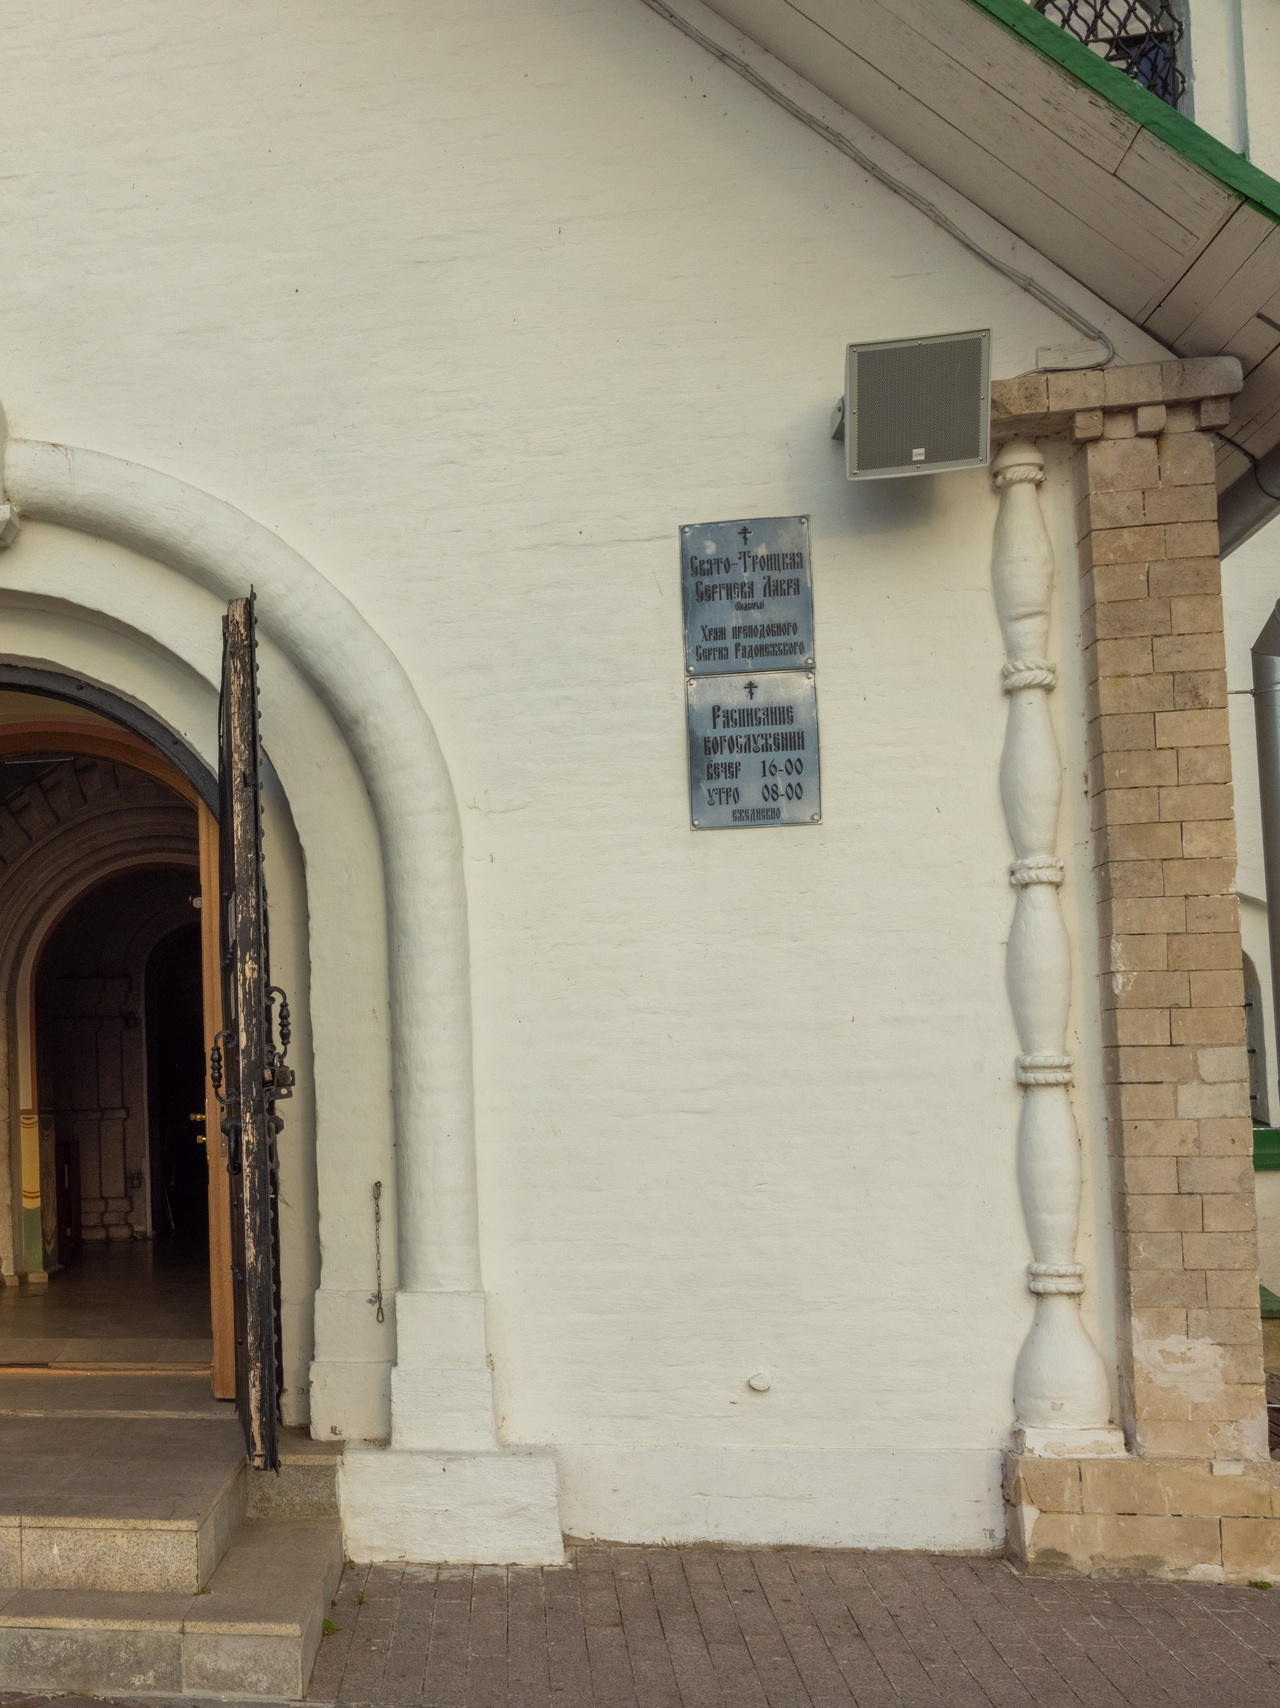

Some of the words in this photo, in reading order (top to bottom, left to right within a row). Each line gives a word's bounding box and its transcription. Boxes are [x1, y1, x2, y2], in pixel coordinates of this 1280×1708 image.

[689, 550, 803, 577] Свято-Троицкая
[695, 581, 754, 602] Сергиева
[763, 575, 800, 598] Лавра
[701, 625, 727, 642] Храм
[732, 622, 798, 640] преподобного
[696, 645, 729, 662] Сергия
[734, 641, 805, 659] Радонежского
[712, 705, 794, 729] Расписание
[703, 729, 805, 755] богослужений
[706, 761, 741, 780] вечер
[761, 757, 803, 777] 16-00
[707, 787, 740, 806] утро
[762, 782, 803, 802] 08-00
[732, 807, 781, 822] ежедневно
